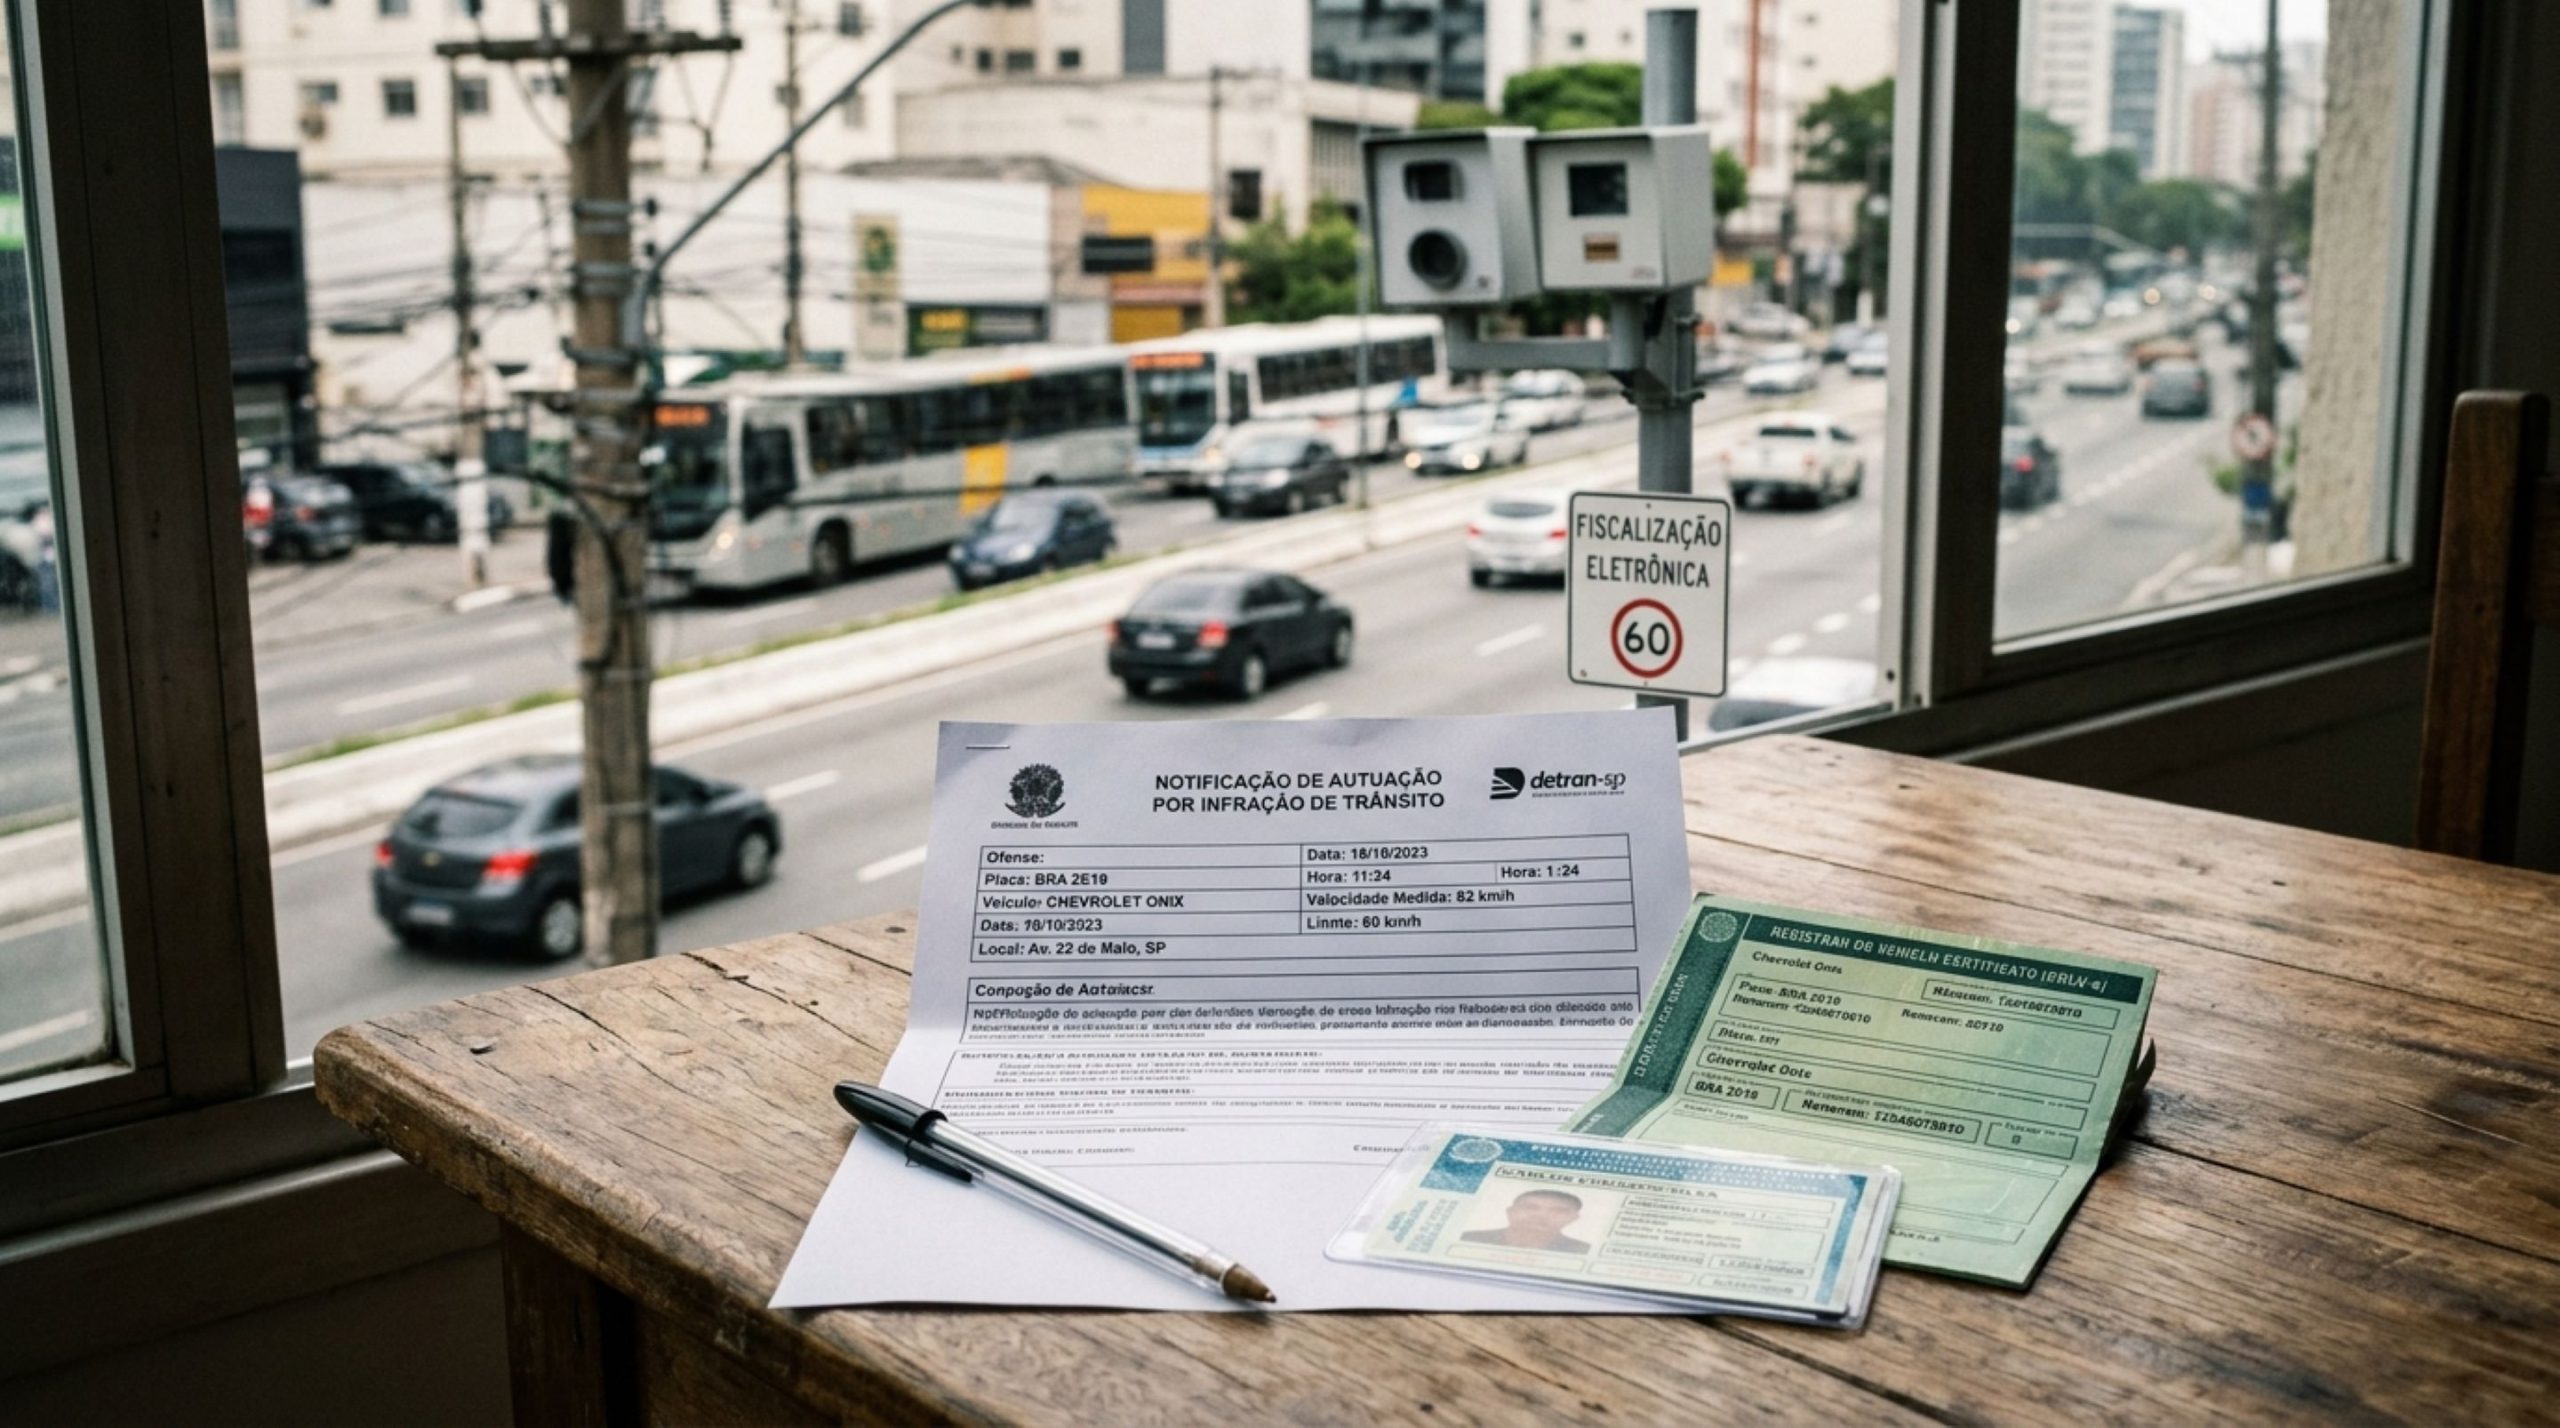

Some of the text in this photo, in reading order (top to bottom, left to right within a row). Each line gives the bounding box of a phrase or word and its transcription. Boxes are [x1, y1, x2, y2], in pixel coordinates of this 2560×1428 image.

[1577, 514, 1721, 550] FISCALIZAÇÃO
[1587, 553, 1710, 588] ELETRÔNICA
[1624, 621, 1670, 656] 60
[1156, 767, 1442, 792] NOTIFICAÇÃO DE AUTUAÇÃO
[1530, 771, 1626, 790] detran-sp
[1153, 797, 1195, 812] POR
[1311, 795, 1337, 811] DE
[1343, 791, 1445, 810] TRÂNSITO
[987, 851, 1044, 864] Ofense:
[1307, 848, 1345, 862] Data:
[1034, 873, 1067, 886] BRA
[1307, 869, 1391, 884] Hora: 11:24
[1501, 866, 1541, 879] Hora:
[1046, 895, 1142, 908] CHEVROLET
[1146, 895, 1184, 908] ONIX
[1456, 890, 1475, 903] 82
[1362, 915, 1380, 928] 60
[979, 943, 1025, 956] Local:
[1028, 942, 1052, 955] Av.
[1056, 942, 1074, 954] 22
[1078, 941, 1096, 955] de
[1145, 941, 1167, 954] SP
[1056, 983, 1074, 996] de
